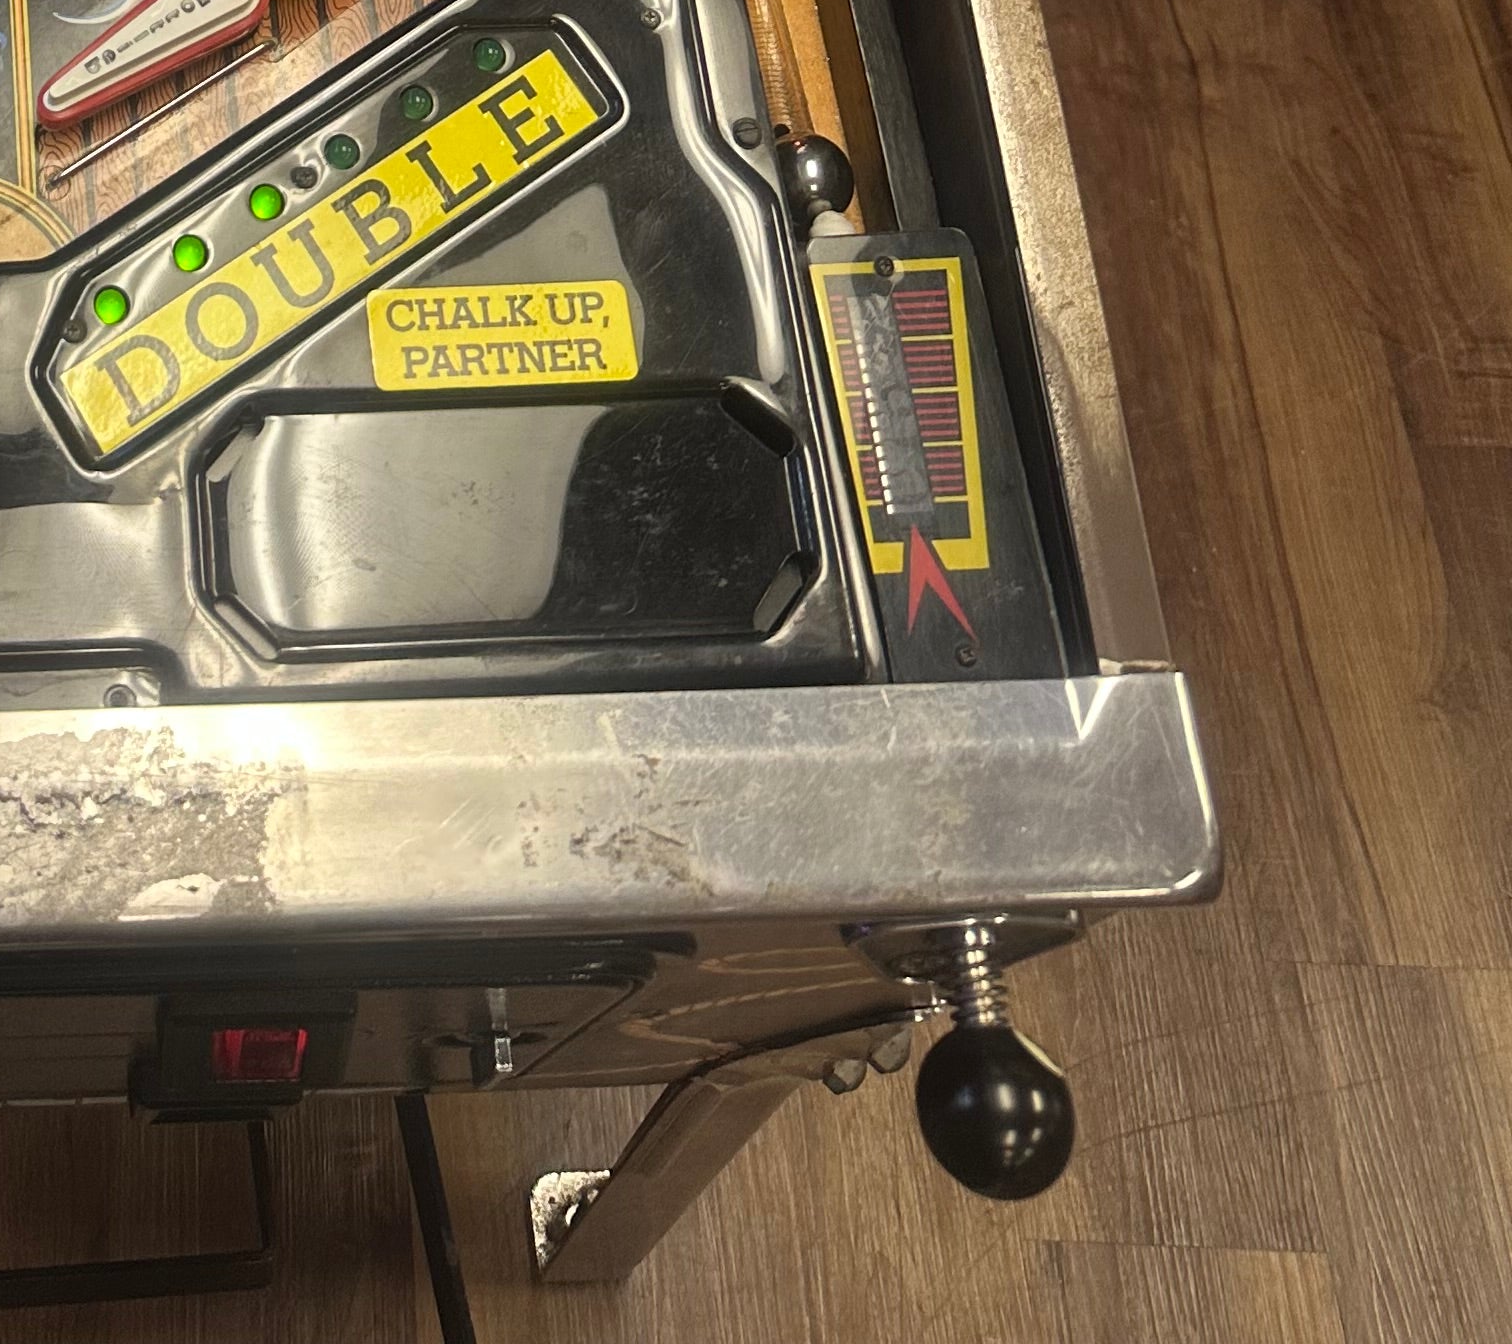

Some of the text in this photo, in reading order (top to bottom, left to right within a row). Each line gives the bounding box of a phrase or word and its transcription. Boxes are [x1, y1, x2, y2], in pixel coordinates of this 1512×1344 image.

[95, 73, 566, 427] DOUBLE
[384, 293, 612, 332] CHALK UP,
[402, 337, 608, 378] PARTNER
